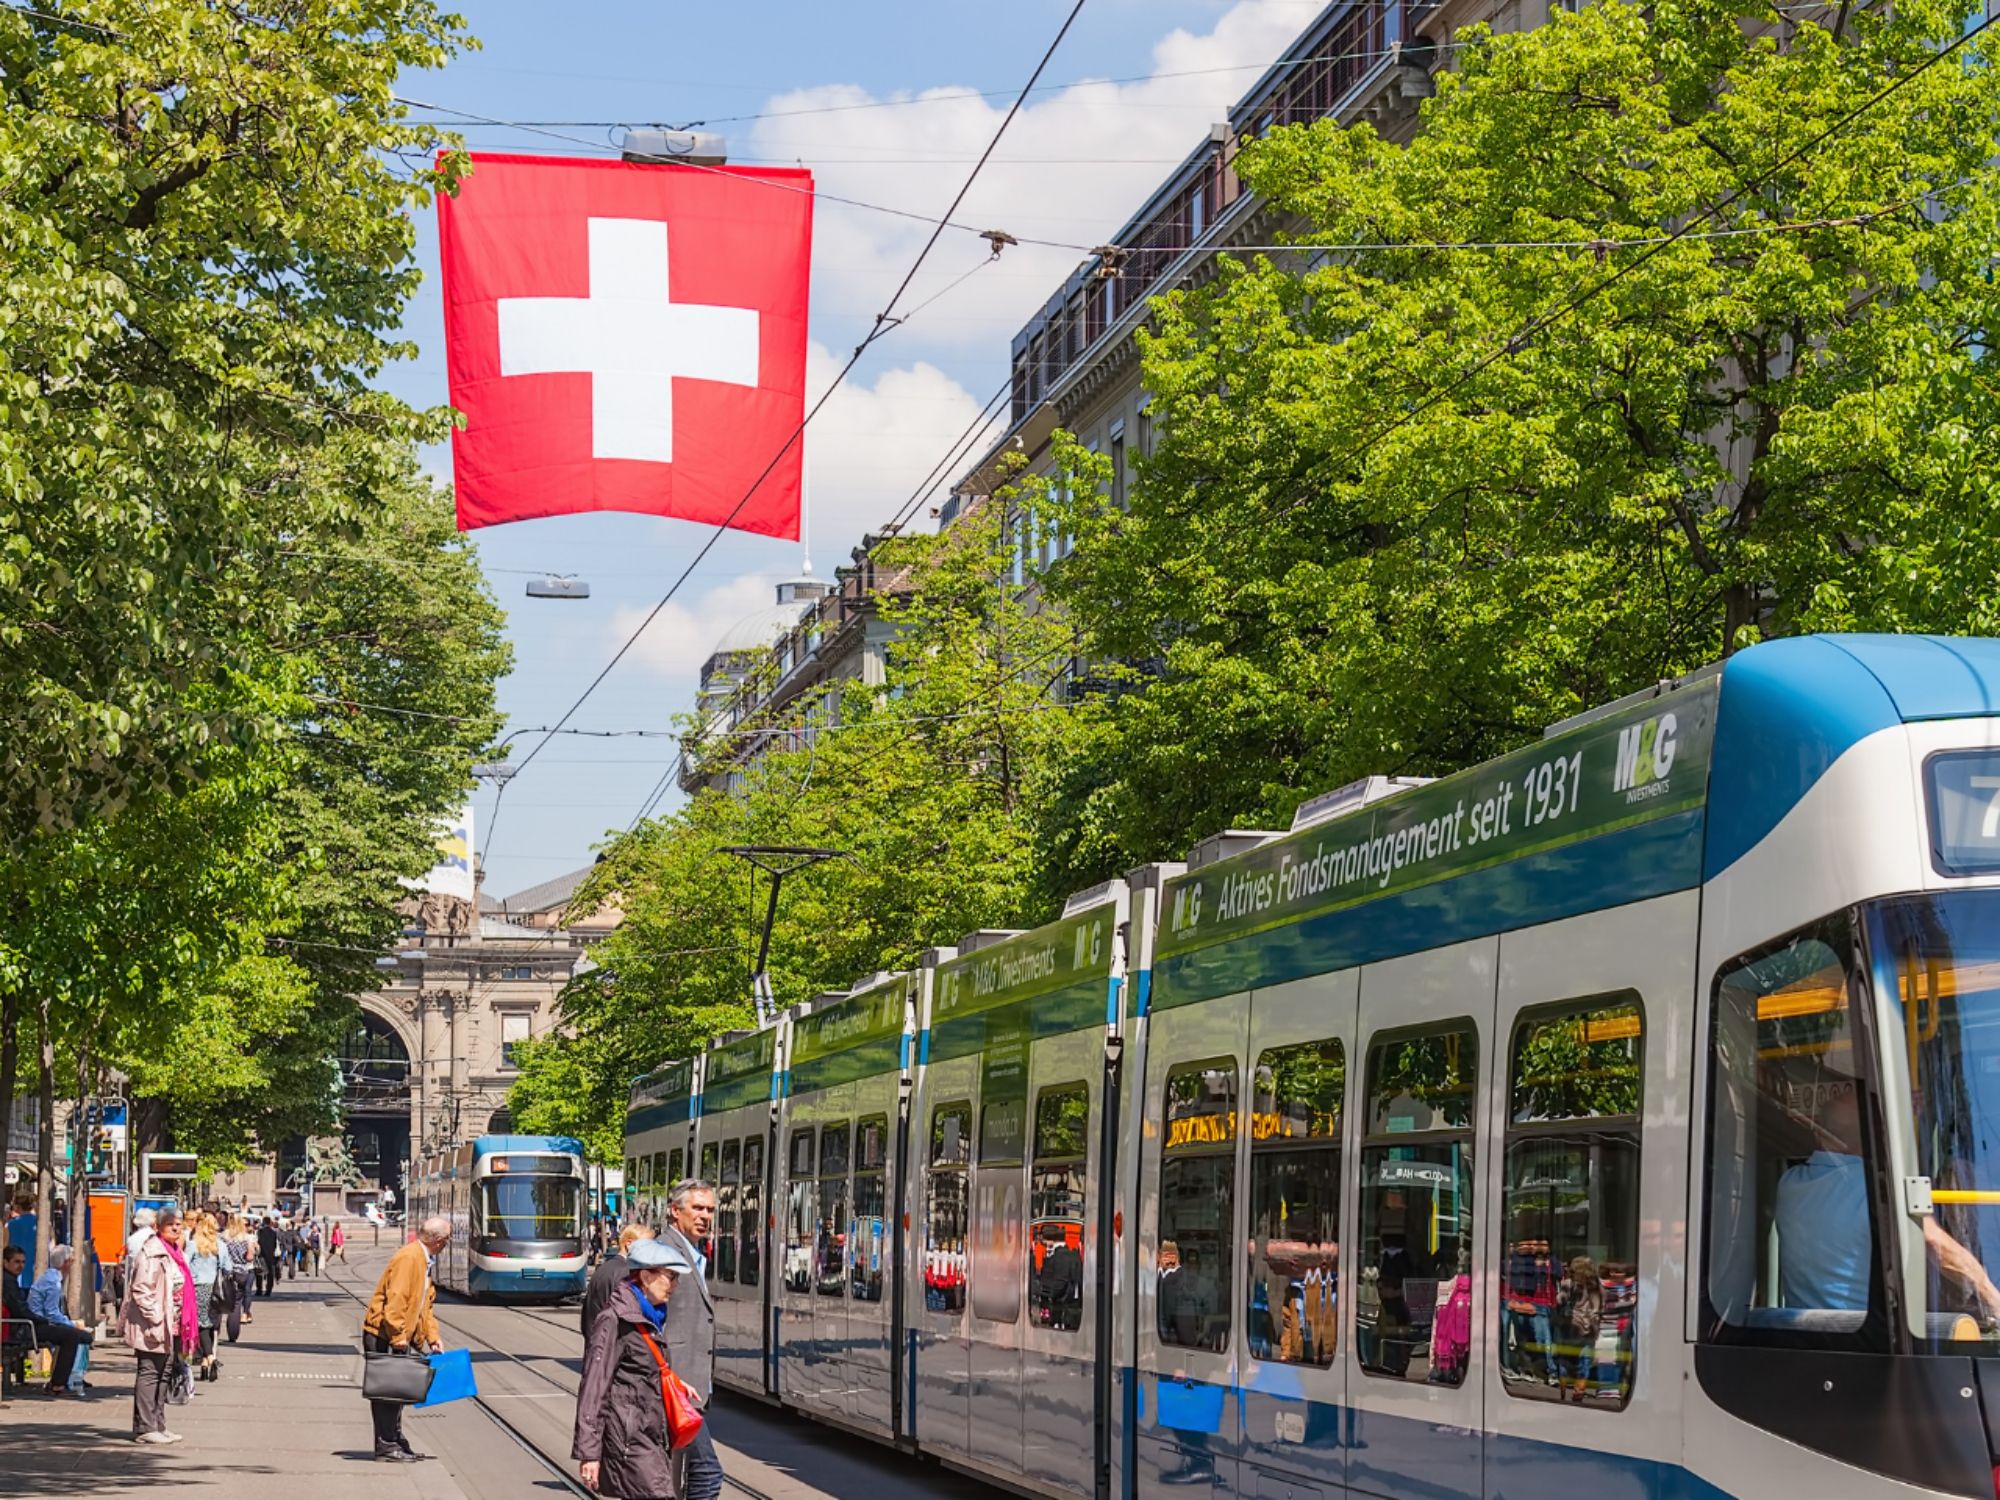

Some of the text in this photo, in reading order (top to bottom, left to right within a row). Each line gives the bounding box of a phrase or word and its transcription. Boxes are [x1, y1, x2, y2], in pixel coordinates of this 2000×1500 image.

[1614, 713, 1677, 793] M&G
[1626, 780, 1671, 804] INVESTMENTS
[1216, 751, 1582, 923] Aktives Fondsmanagement seit 1931
[997, 943, 1056, 990] Investments
